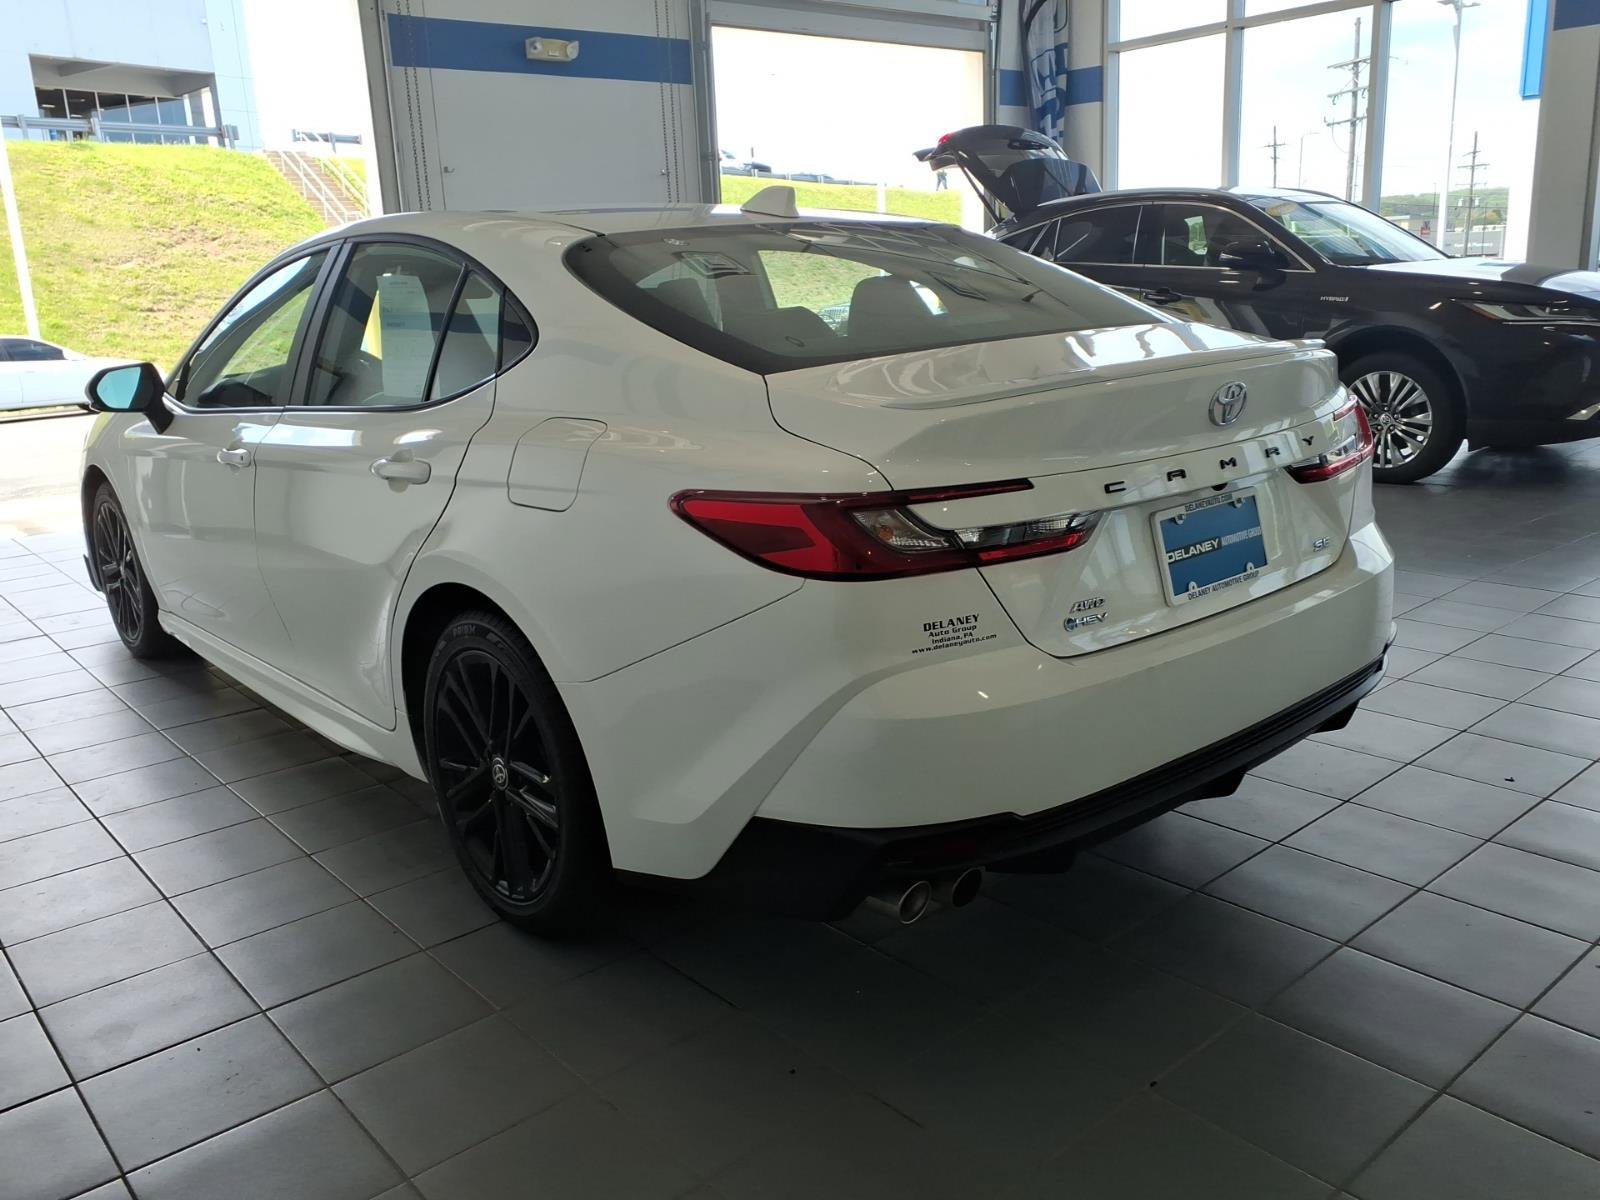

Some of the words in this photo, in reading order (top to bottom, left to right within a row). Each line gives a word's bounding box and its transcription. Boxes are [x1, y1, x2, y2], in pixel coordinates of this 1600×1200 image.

[1104, 435, 1315, 494] CAMRY
[1166, 538, 1220, 563] DELANEY
[1188, 586, 1212, 600] DELANEY
[1212, 575, 1242, 592] AUTOMOTIVE
[1242, 570, 1260, 582] GROUP
[923, 613, 980, 632] DELANEY
[1075, 612, 1109, 628] HEV
[928, 629, 950, 638] Auto
[952, 624, 978, 634] Group
[931, 635, 963, 645] Indiana,
[963, 631, 974, 639] PA
[911, 633, 998, 654] www.delaneyauto.com
